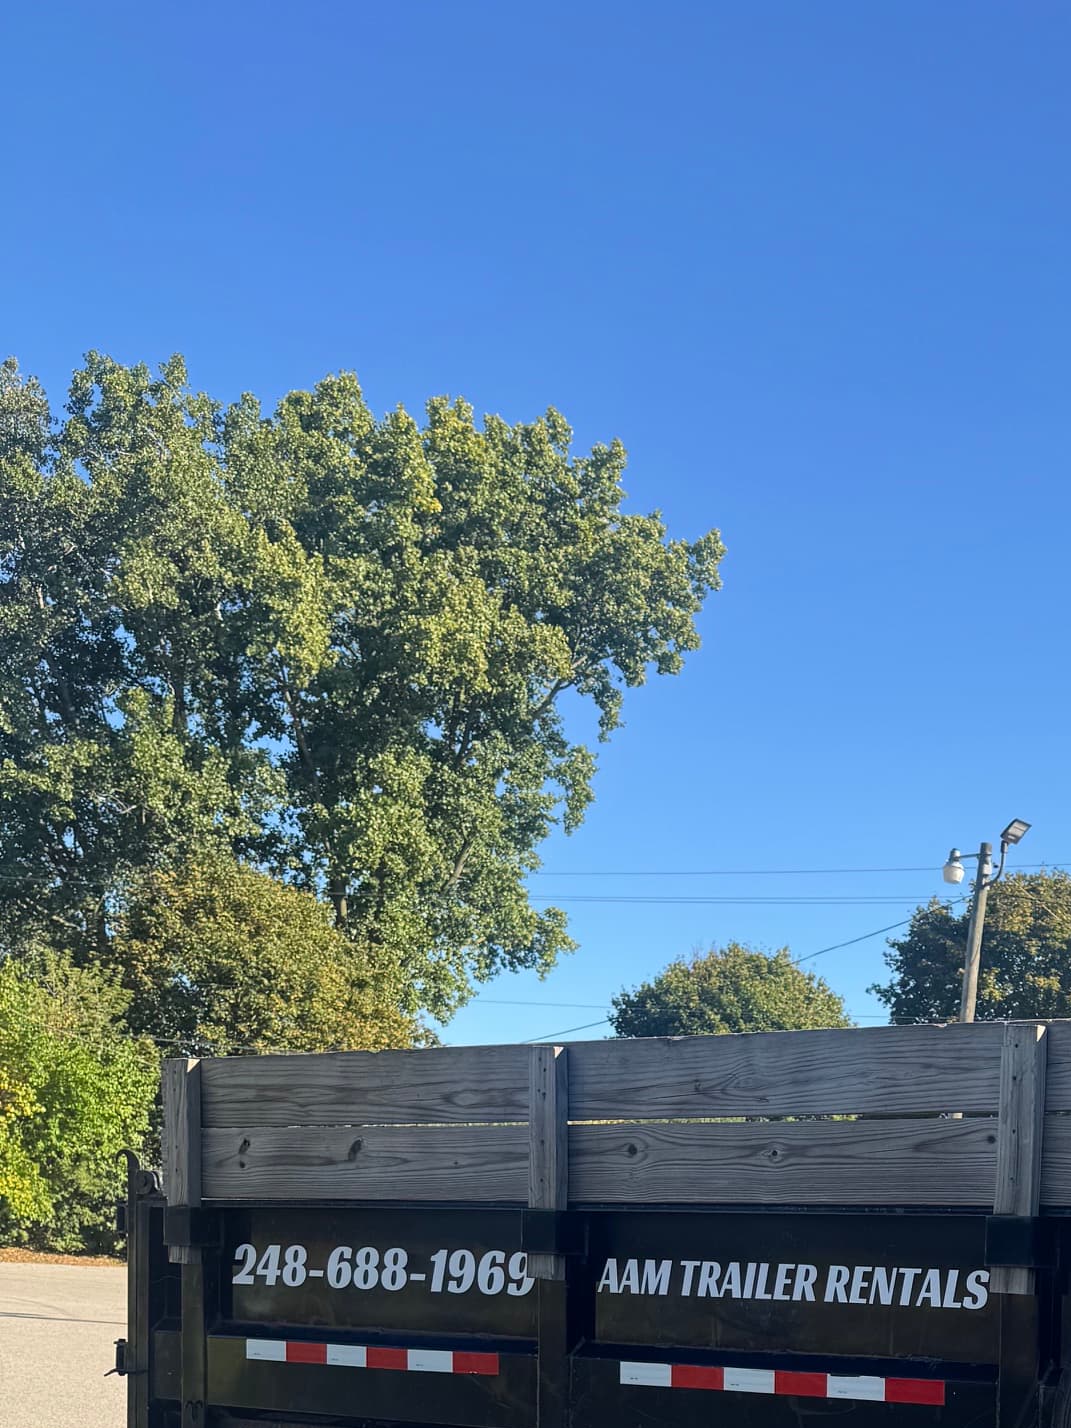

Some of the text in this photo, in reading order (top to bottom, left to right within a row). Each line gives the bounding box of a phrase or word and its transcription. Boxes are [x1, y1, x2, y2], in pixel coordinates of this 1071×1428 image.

[231, 1243, 536, 1297] 248-688-1969
[597, 1257, 990, 1310] AAM TRAILER RENTALS
